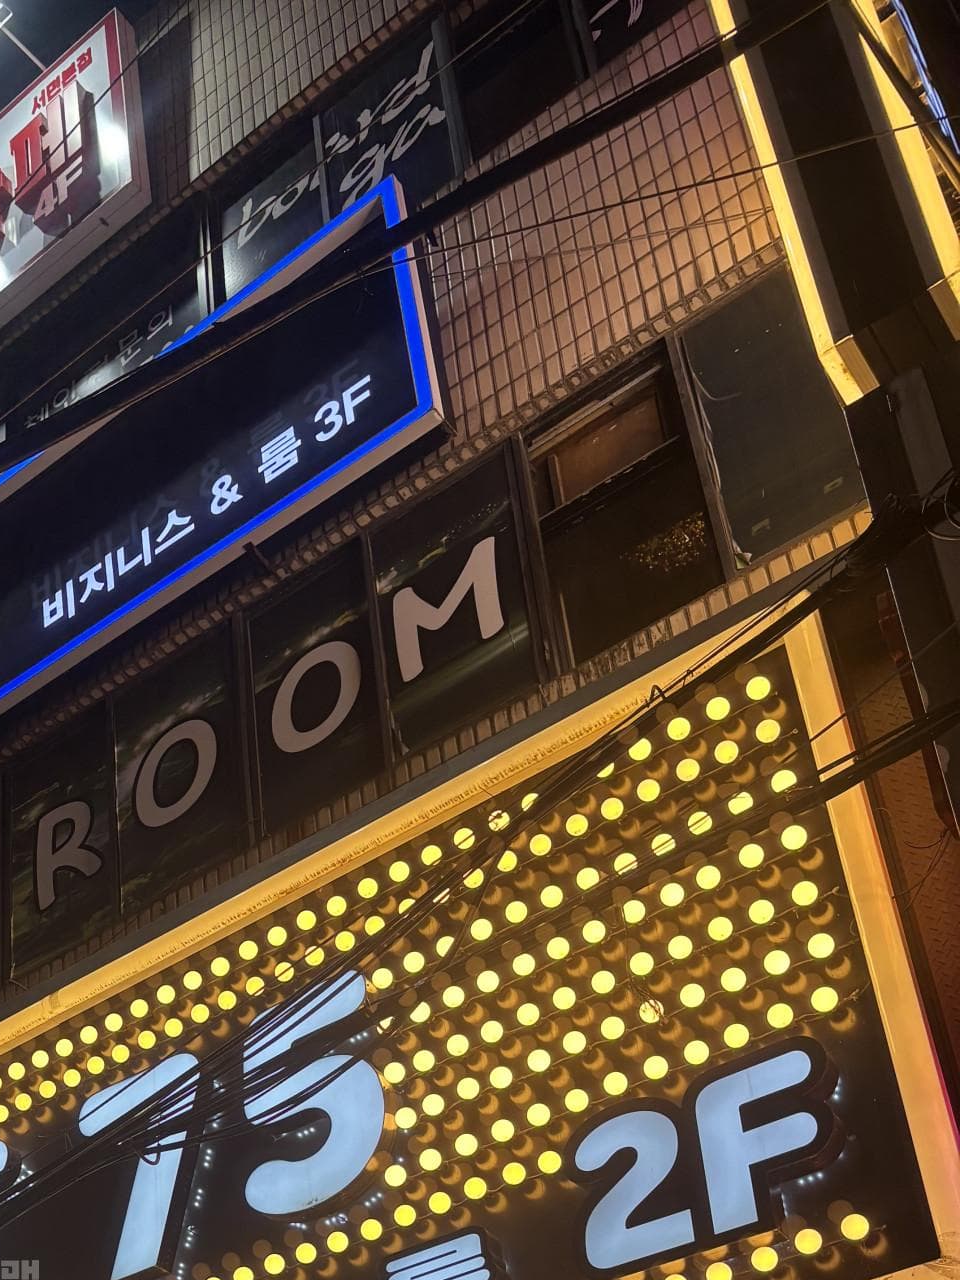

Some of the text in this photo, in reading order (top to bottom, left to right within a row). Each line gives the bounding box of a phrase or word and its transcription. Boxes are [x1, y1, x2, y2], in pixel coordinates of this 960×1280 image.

[32, 47, 94, 115] 서면본점
[33, 155, 83, 224] 4F
[42, 510, 195, 629] 비지니스
[209, 473, 244, 517] &
[257, 430, 303, 485] 룸
[313, 376, 372, 444] 3F
[37, 536, 505, 911] ROOM
[575, 1050, 818, 1269] 2F
